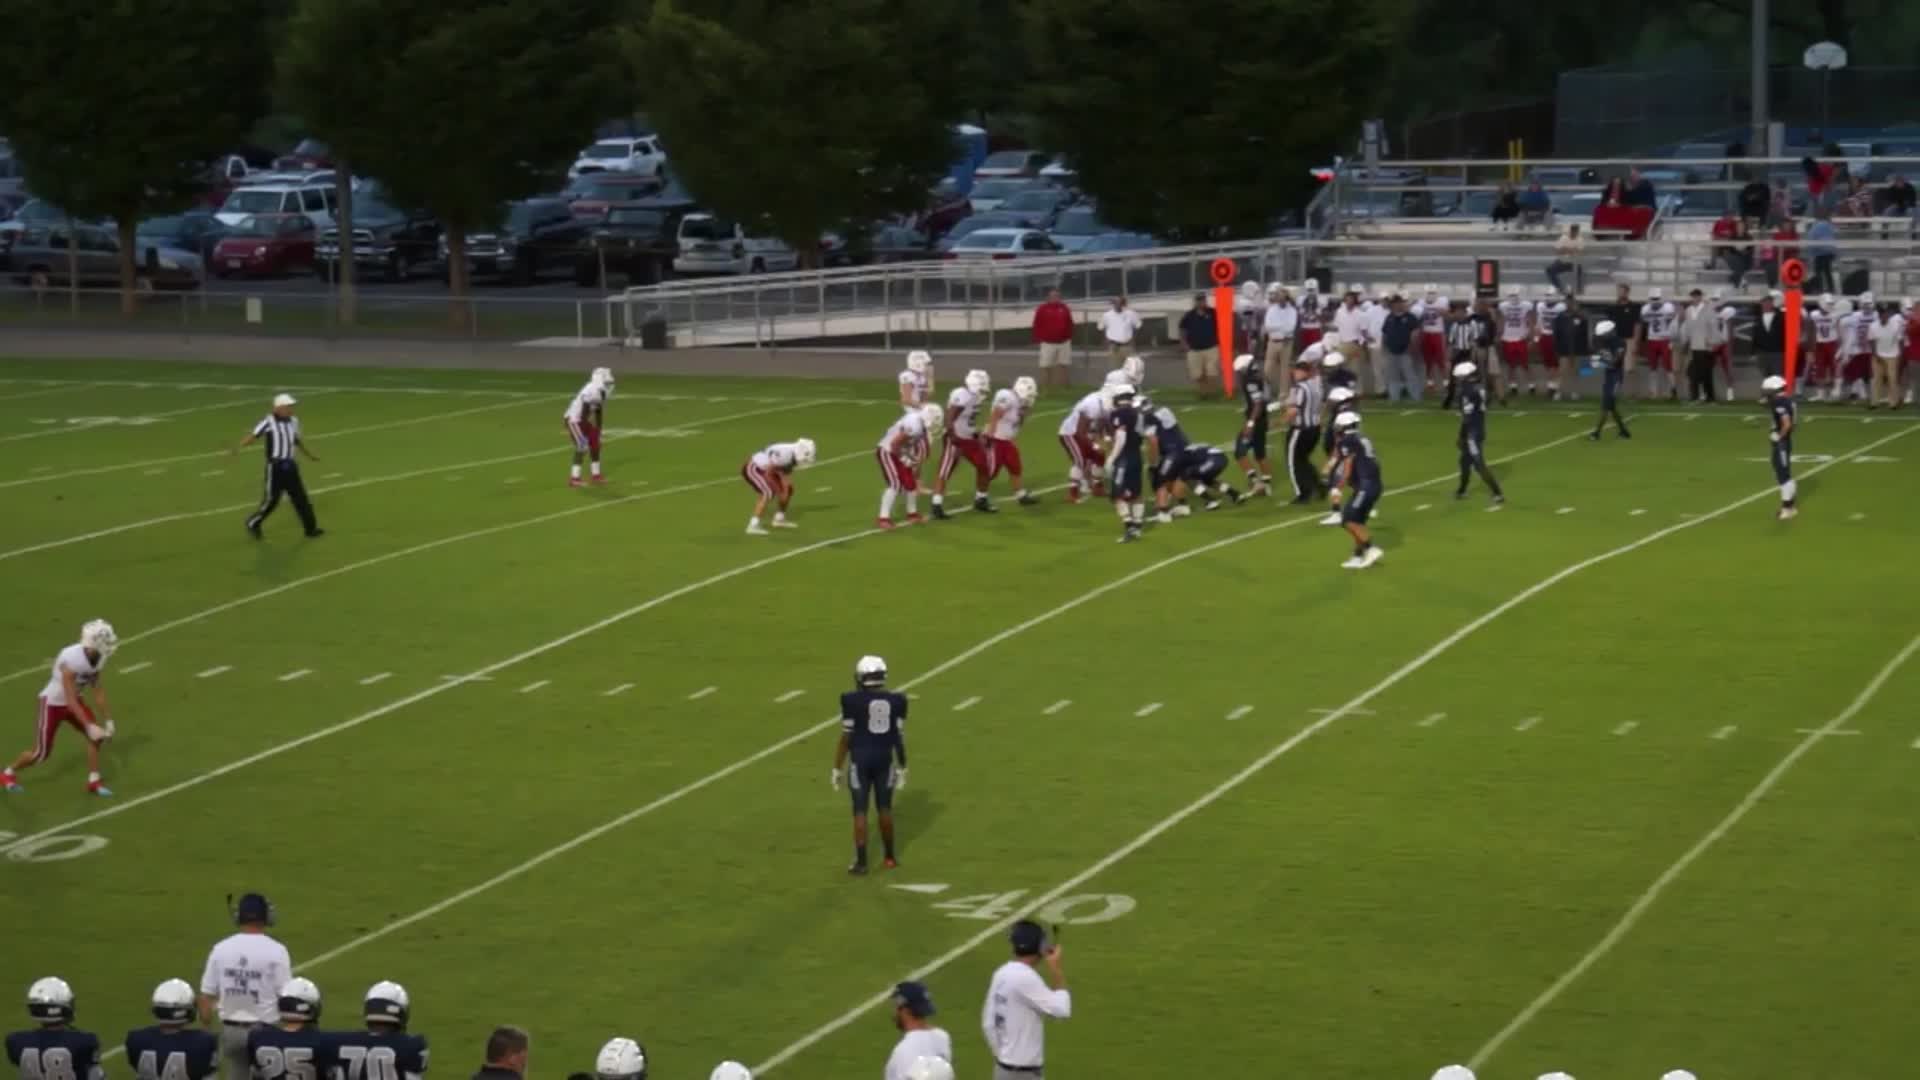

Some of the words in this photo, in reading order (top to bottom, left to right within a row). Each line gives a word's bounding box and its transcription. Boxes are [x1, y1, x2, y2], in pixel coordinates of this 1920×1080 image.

[868, 699, 891, 734] 8
[0, 831, 108, 862] 0
[931, 889, 1136, 925] 40
[20, 1047, 76, 1080] 48
[137, 1050, 189, 1080] 44
[255, 1046, 317, 1080] 25
[339, 1046, 399, 1080] 70
